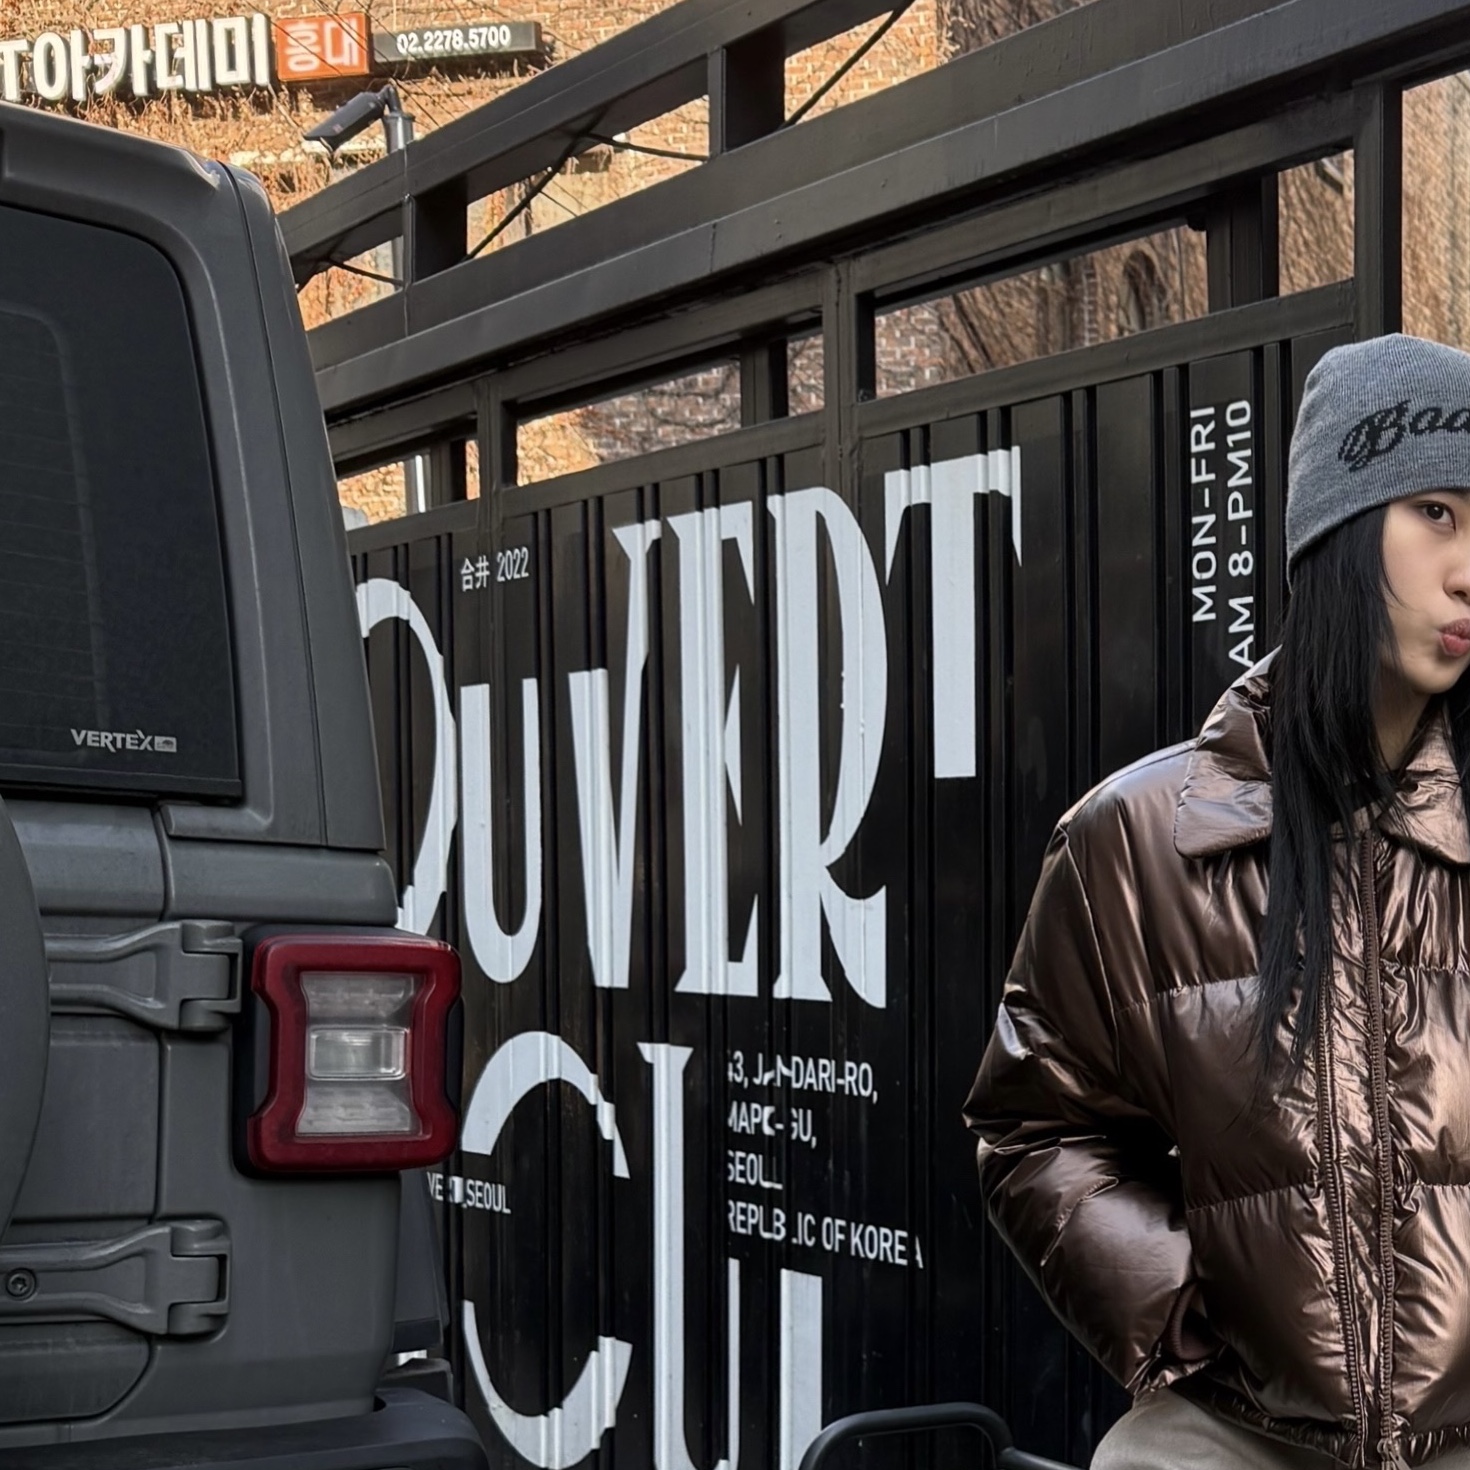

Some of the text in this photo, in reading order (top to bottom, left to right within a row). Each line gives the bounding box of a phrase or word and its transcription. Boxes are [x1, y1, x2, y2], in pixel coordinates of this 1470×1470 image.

[286, 17, 359, 74] 홍대
[396, 24, 512, 55] 02.2278.5700
[1190, 406, 1217, 623] MON-FRI
[1225, 399, 1254, 670] AM 8-PM10
[460, 546, 530, 593] 合井 2022
[70, 728, 154, 754] VERTEX
[821, 1215, 847, 1253] OF
